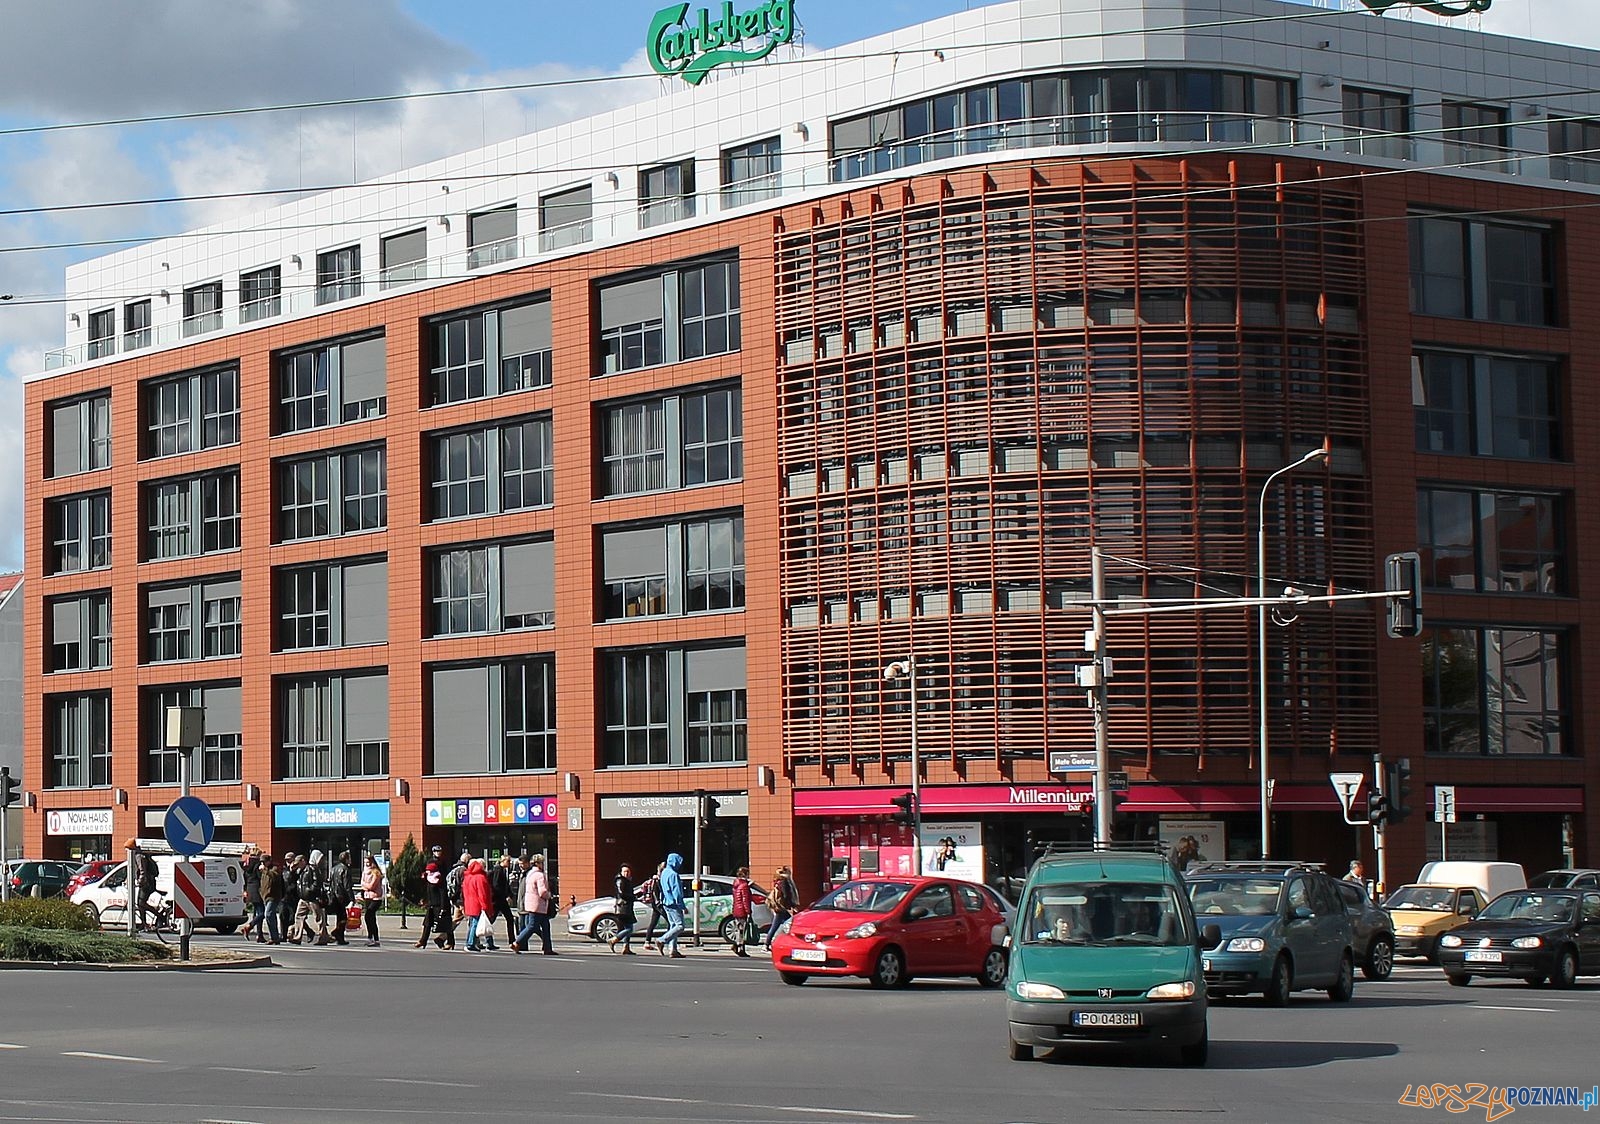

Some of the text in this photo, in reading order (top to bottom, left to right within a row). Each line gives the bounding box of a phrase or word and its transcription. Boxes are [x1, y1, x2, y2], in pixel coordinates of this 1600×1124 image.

[647, 0, 795, 85] Carlsberg
[1071, 757, 1095, 766] Garbary
[1009, 787, 1095, 803] Millennium
[640, 797, 673, 806] GARBARY
[67, 812, 109, 823] NOVA HAUS
[572, 818, 578, 828] 9
[1081, 1013, 1138, 1025] PO 0438H
